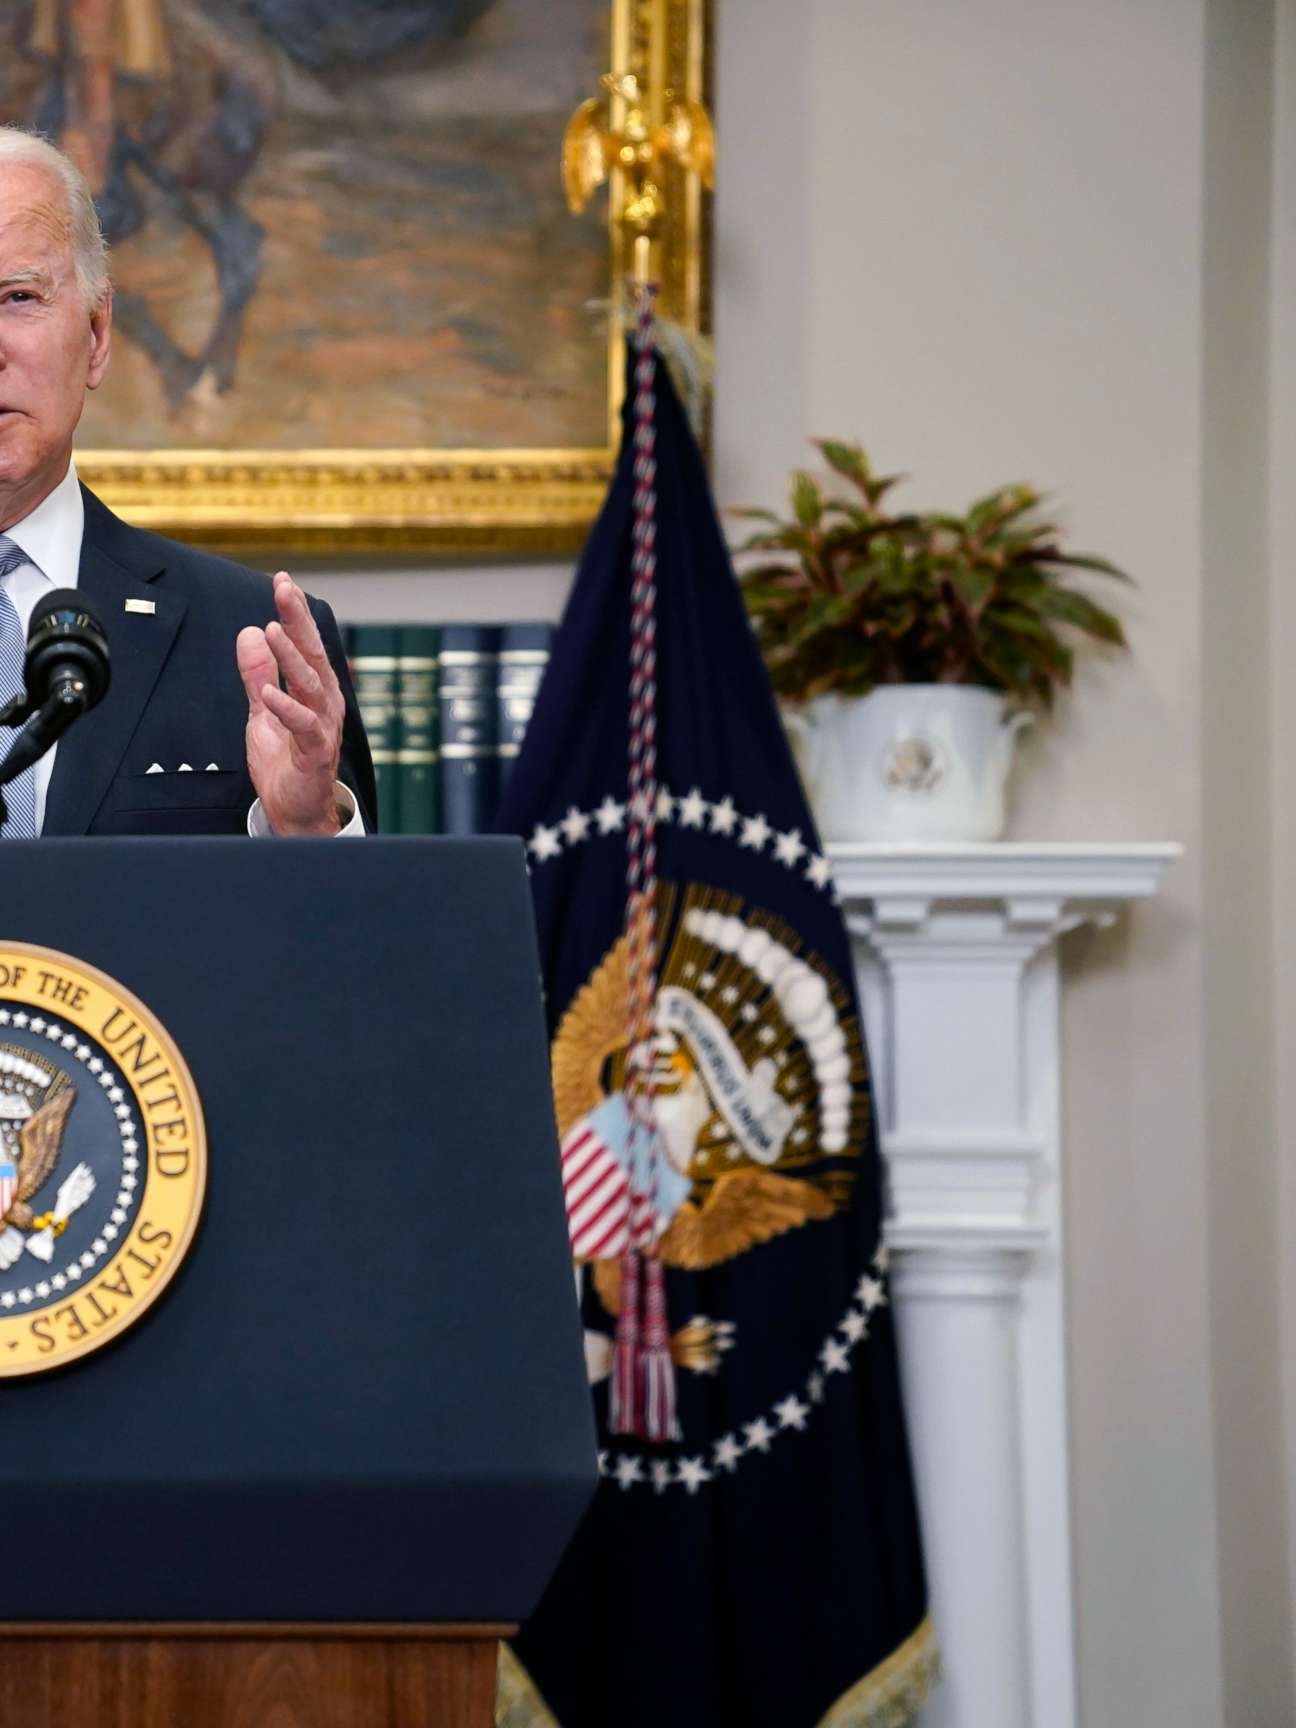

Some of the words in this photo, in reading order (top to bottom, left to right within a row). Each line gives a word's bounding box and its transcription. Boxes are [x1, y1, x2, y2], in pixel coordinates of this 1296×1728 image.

[38, 971, 90, 1011] THE
[101, 1007, 190, 1180] UNITED
[30, 1221, 173, 1352] STATES
